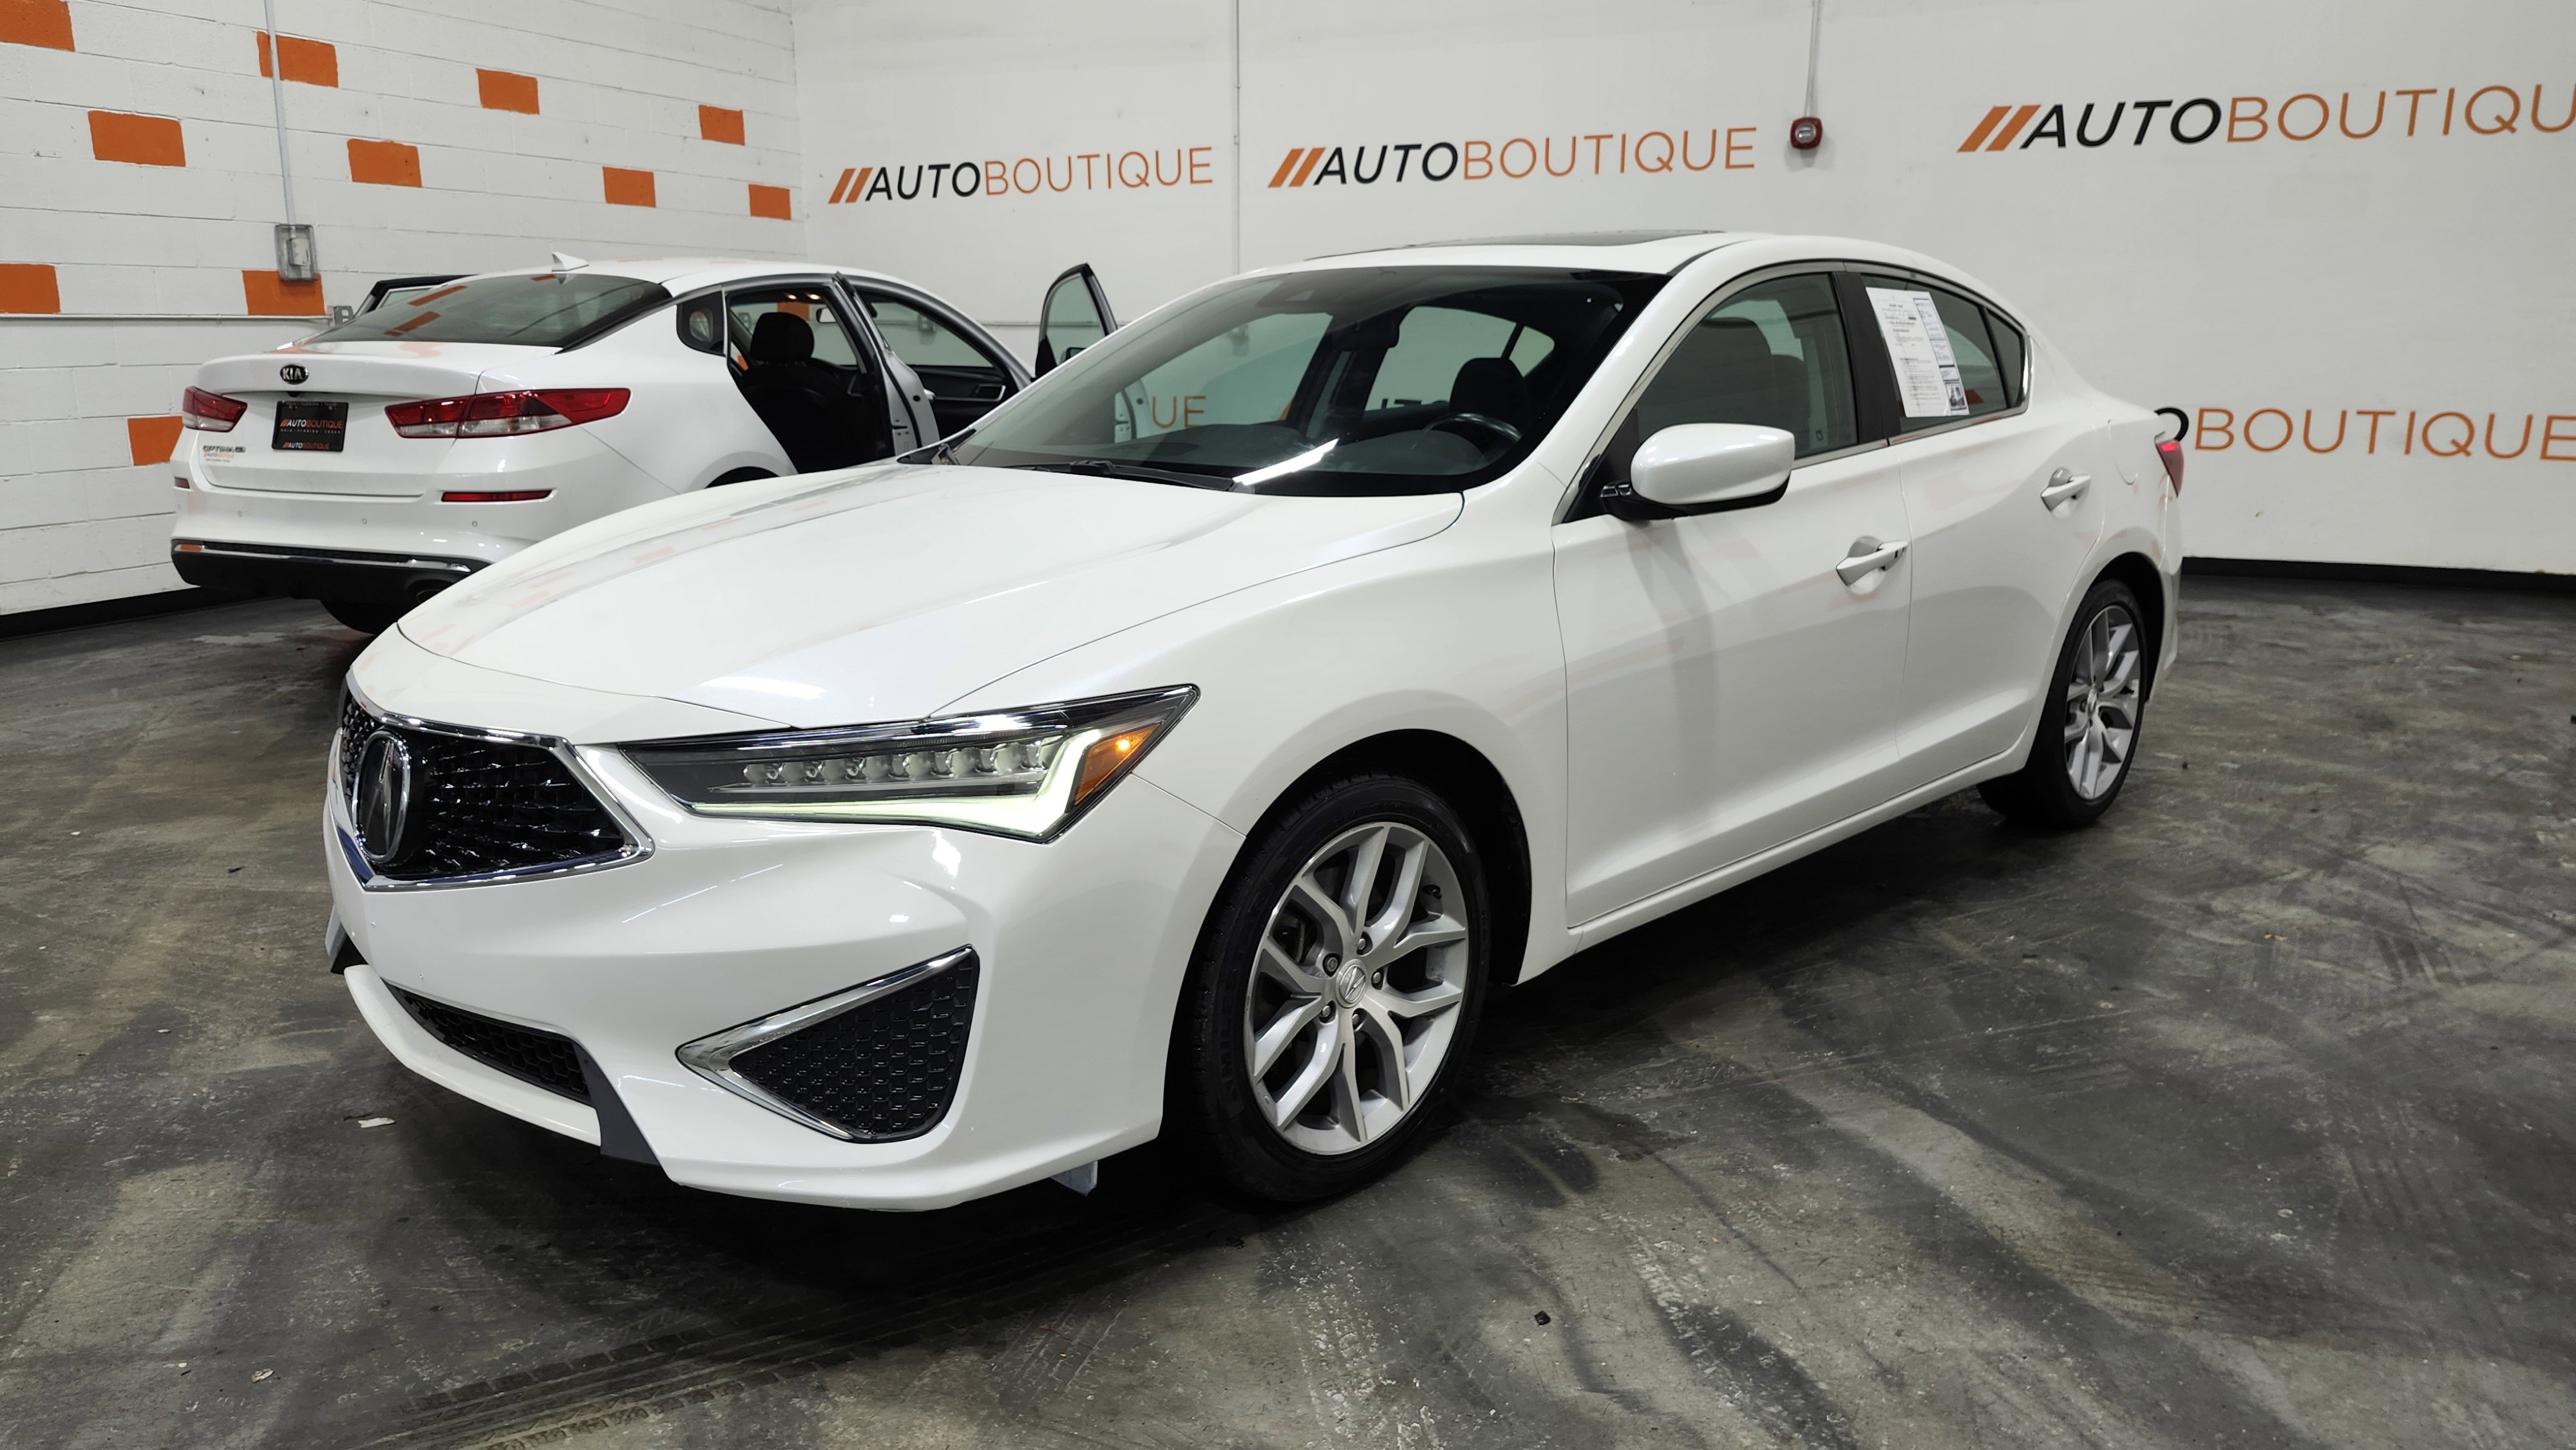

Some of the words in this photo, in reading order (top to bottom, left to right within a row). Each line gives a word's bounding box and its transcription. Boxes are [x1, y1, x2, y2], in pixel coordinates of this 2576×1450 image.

[2020, 83, 2576, 149] AUTOBOUTIQU
[865, 147, 1213, 202] AUTOBOUTIQUE
[1313, 127, 1757, 185] AUTOBOUTIQUE
[283, 367, 303, 381] KIA
[286, 419, 343, 429] AUTOBOUTIQUE
